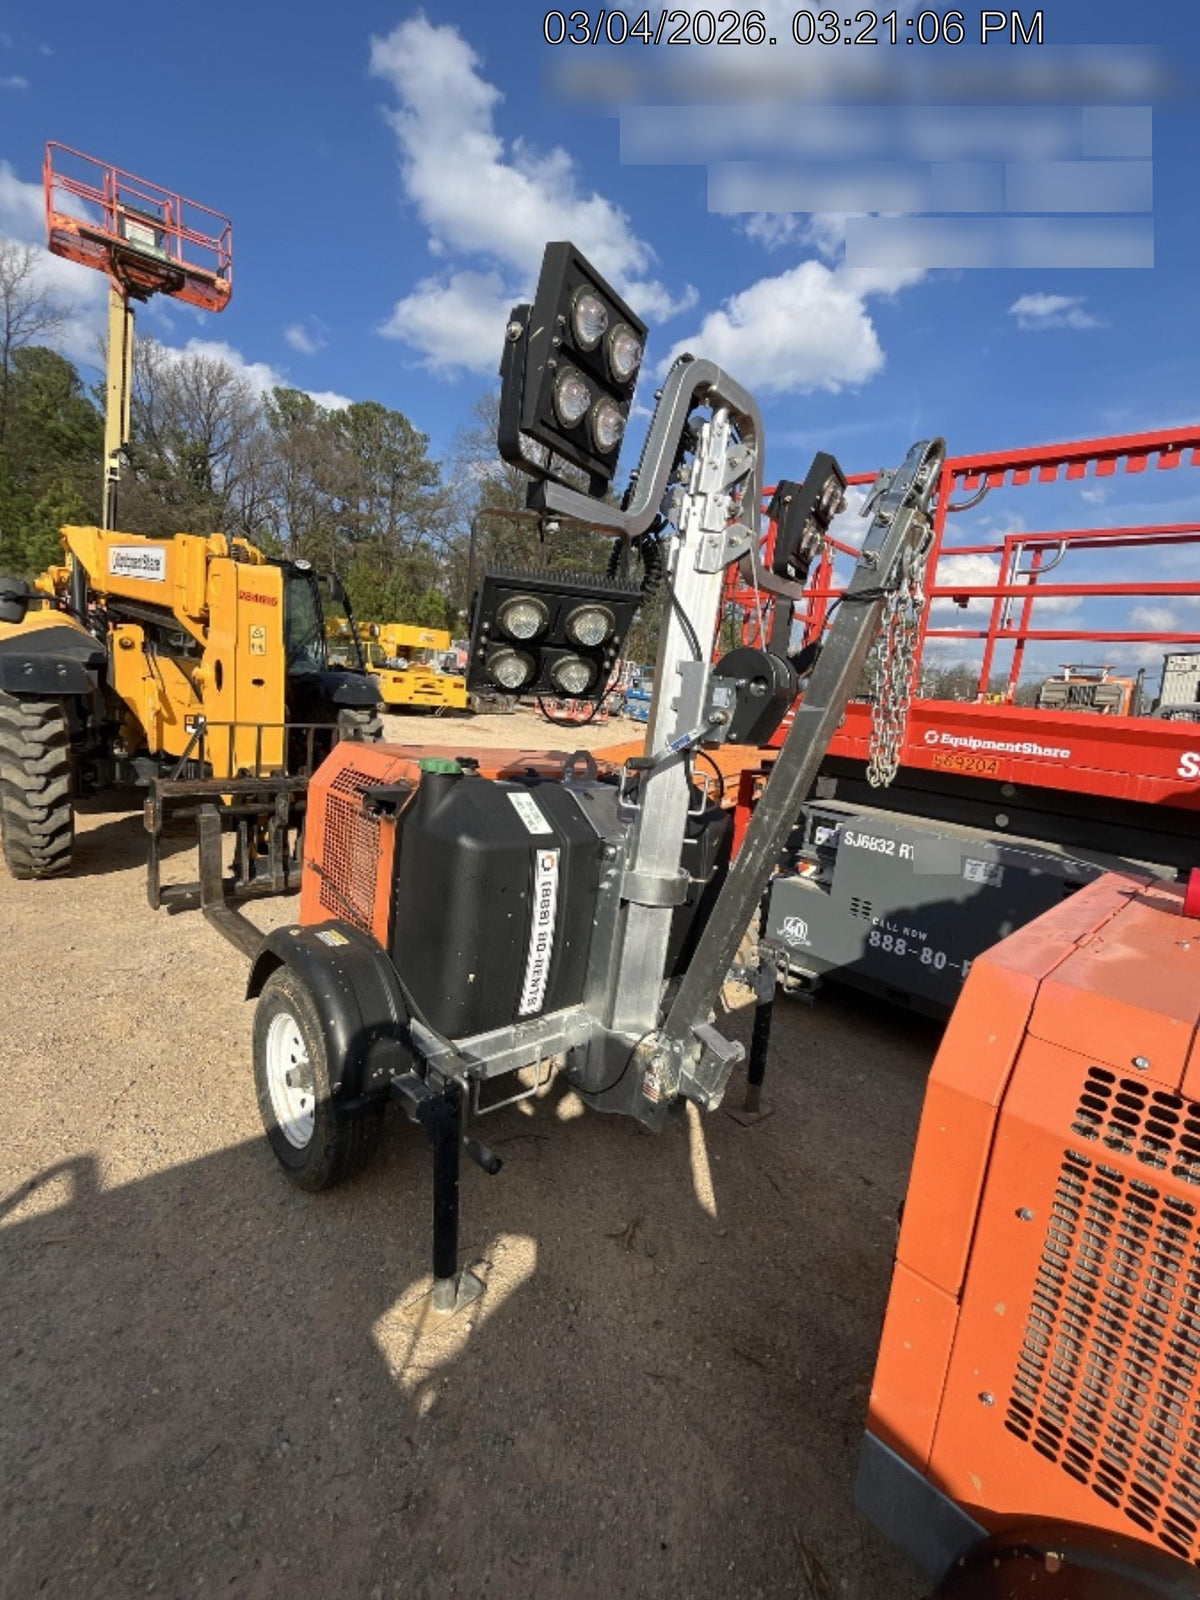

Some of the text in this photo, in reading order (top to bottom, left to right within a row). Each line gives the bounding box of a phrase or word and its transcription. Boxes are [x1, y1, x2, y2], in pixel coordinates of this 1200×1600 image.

[941, 733, 1071, 758] EquipmentShare
[1177, 751, 1200, 778] S
[844, 831, 896, 856] SJ6832
[872, 917, 928, 941] CALL NOW
